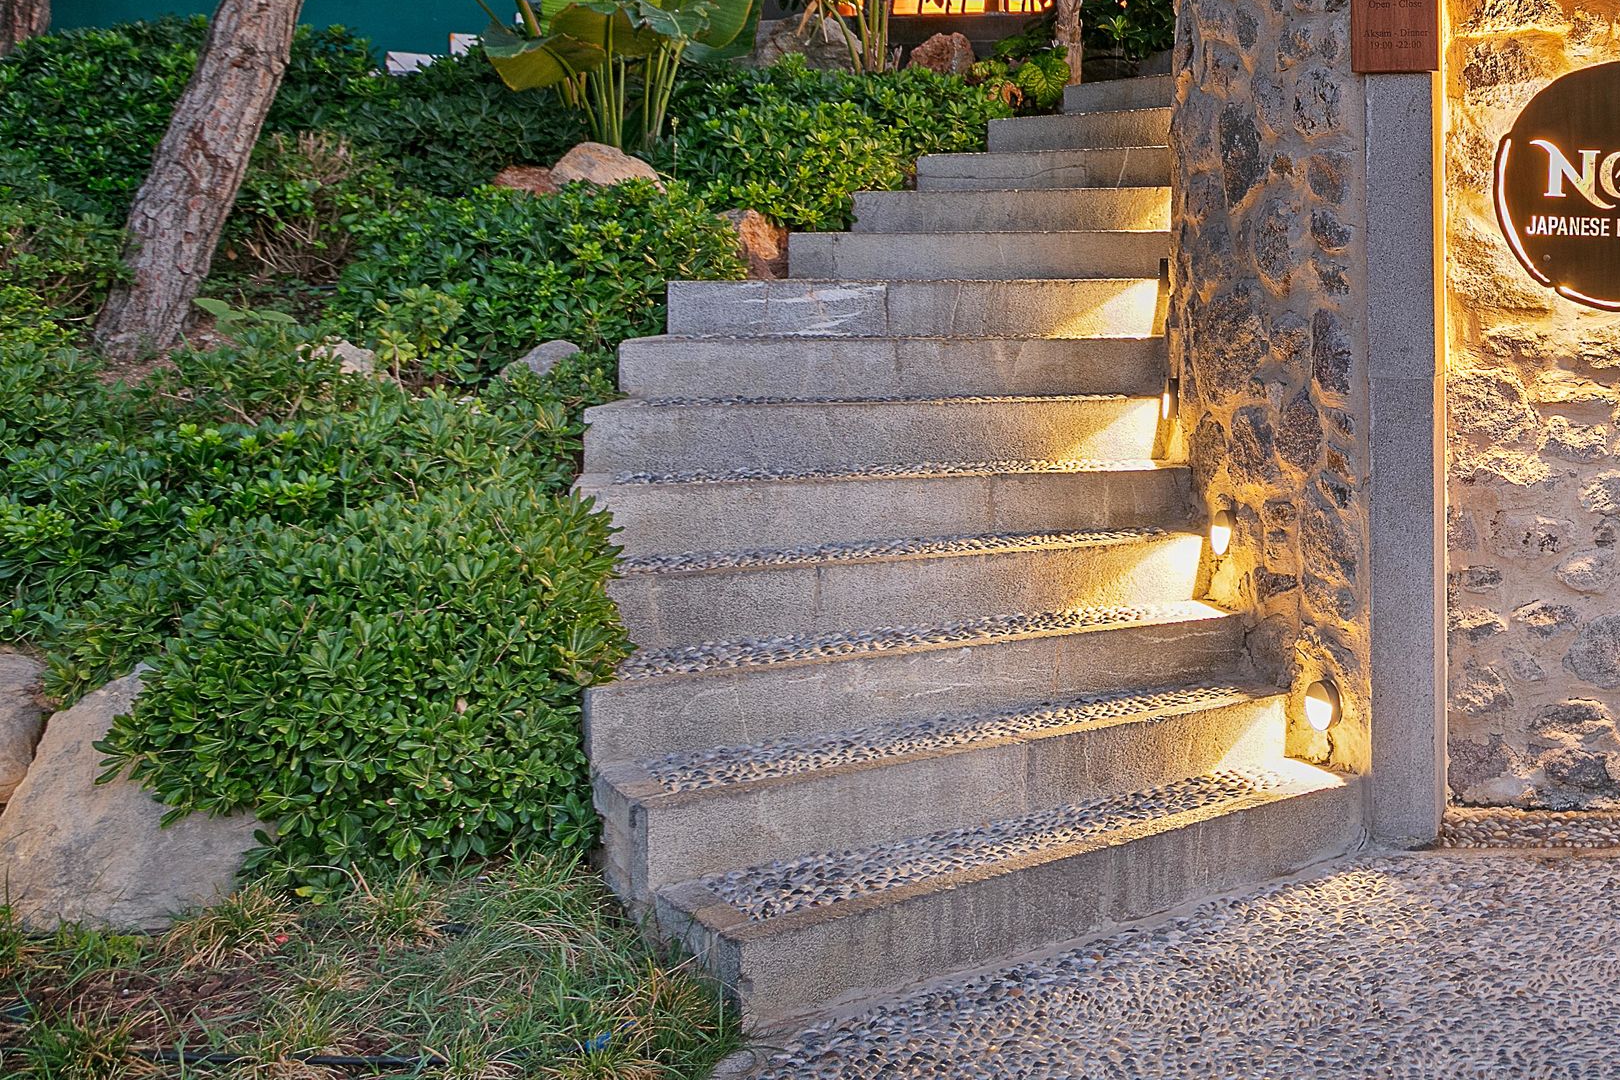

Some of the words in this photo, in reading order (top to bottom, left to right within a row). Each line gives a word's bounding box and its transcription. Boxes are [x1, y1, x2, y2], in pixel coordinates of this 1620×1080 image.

[1368, 0, 1391, 10] Open
[1398, 0, 1422, 8] Close
[1400, 28, 1428, 37] Dinner
[1370, 40, 1393, 49] 19:00
[1525, 215, 1610, 238] JAPANESE
